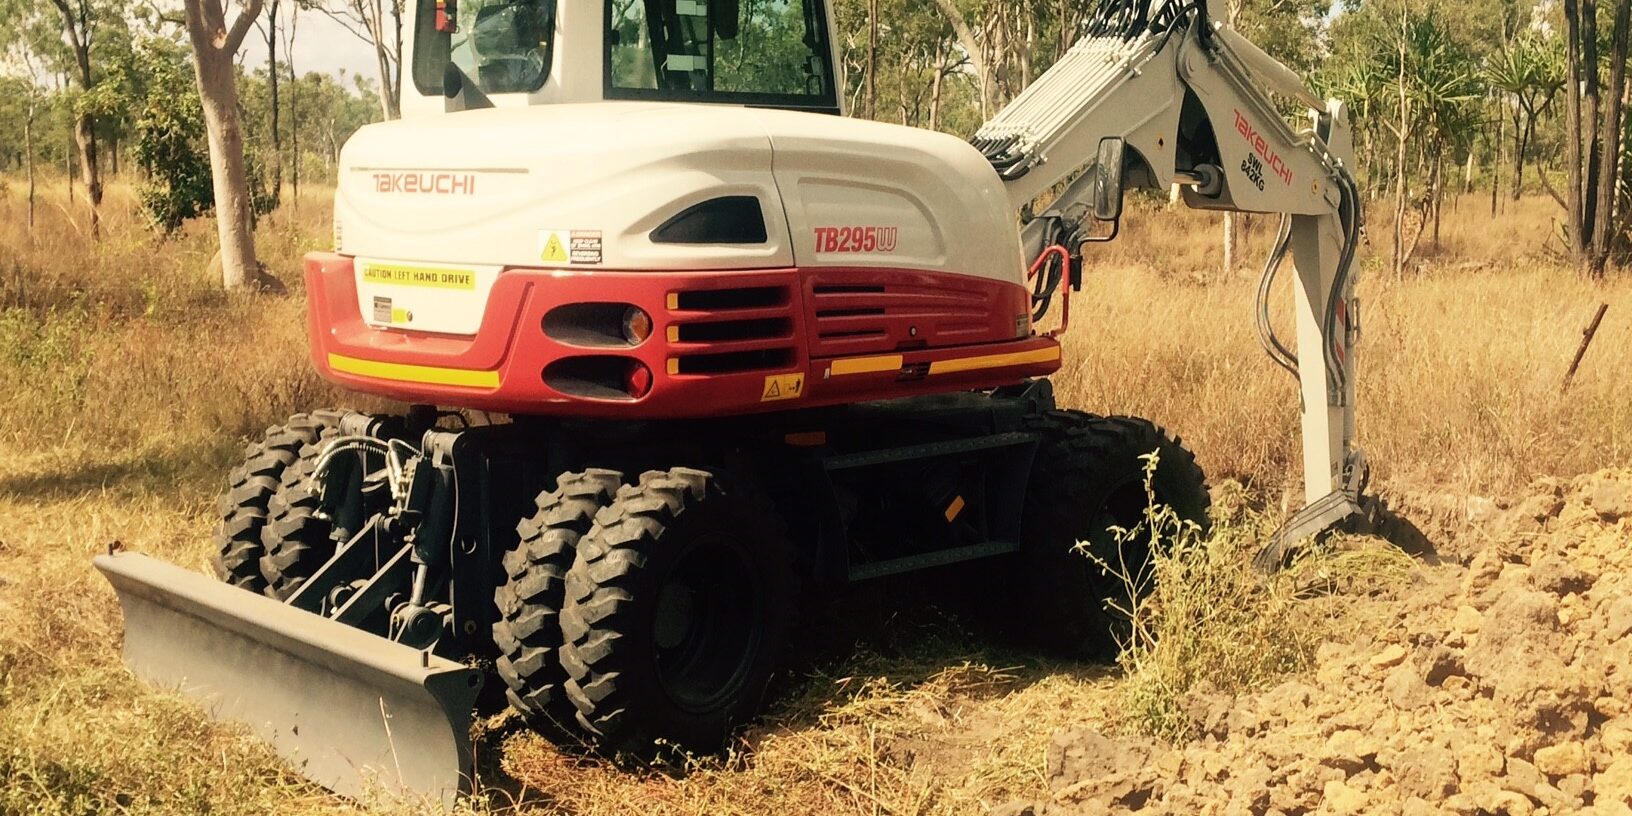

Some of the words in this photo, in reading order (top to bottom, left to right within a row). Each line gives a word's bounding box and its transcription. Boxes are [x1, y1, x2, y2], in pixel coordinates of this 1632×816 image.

[1241, 160, 1265, 191] 842KG
[1248, 152, 1263, 176] SWL
[814, 227, 897, 253] TB295W
[364, 268, 392, 280] CAUTION
[395, 270, 410, 280] LEFT
[413, 272, 438, 283] HAND
[441, 273, 470, 285] DRIVE
